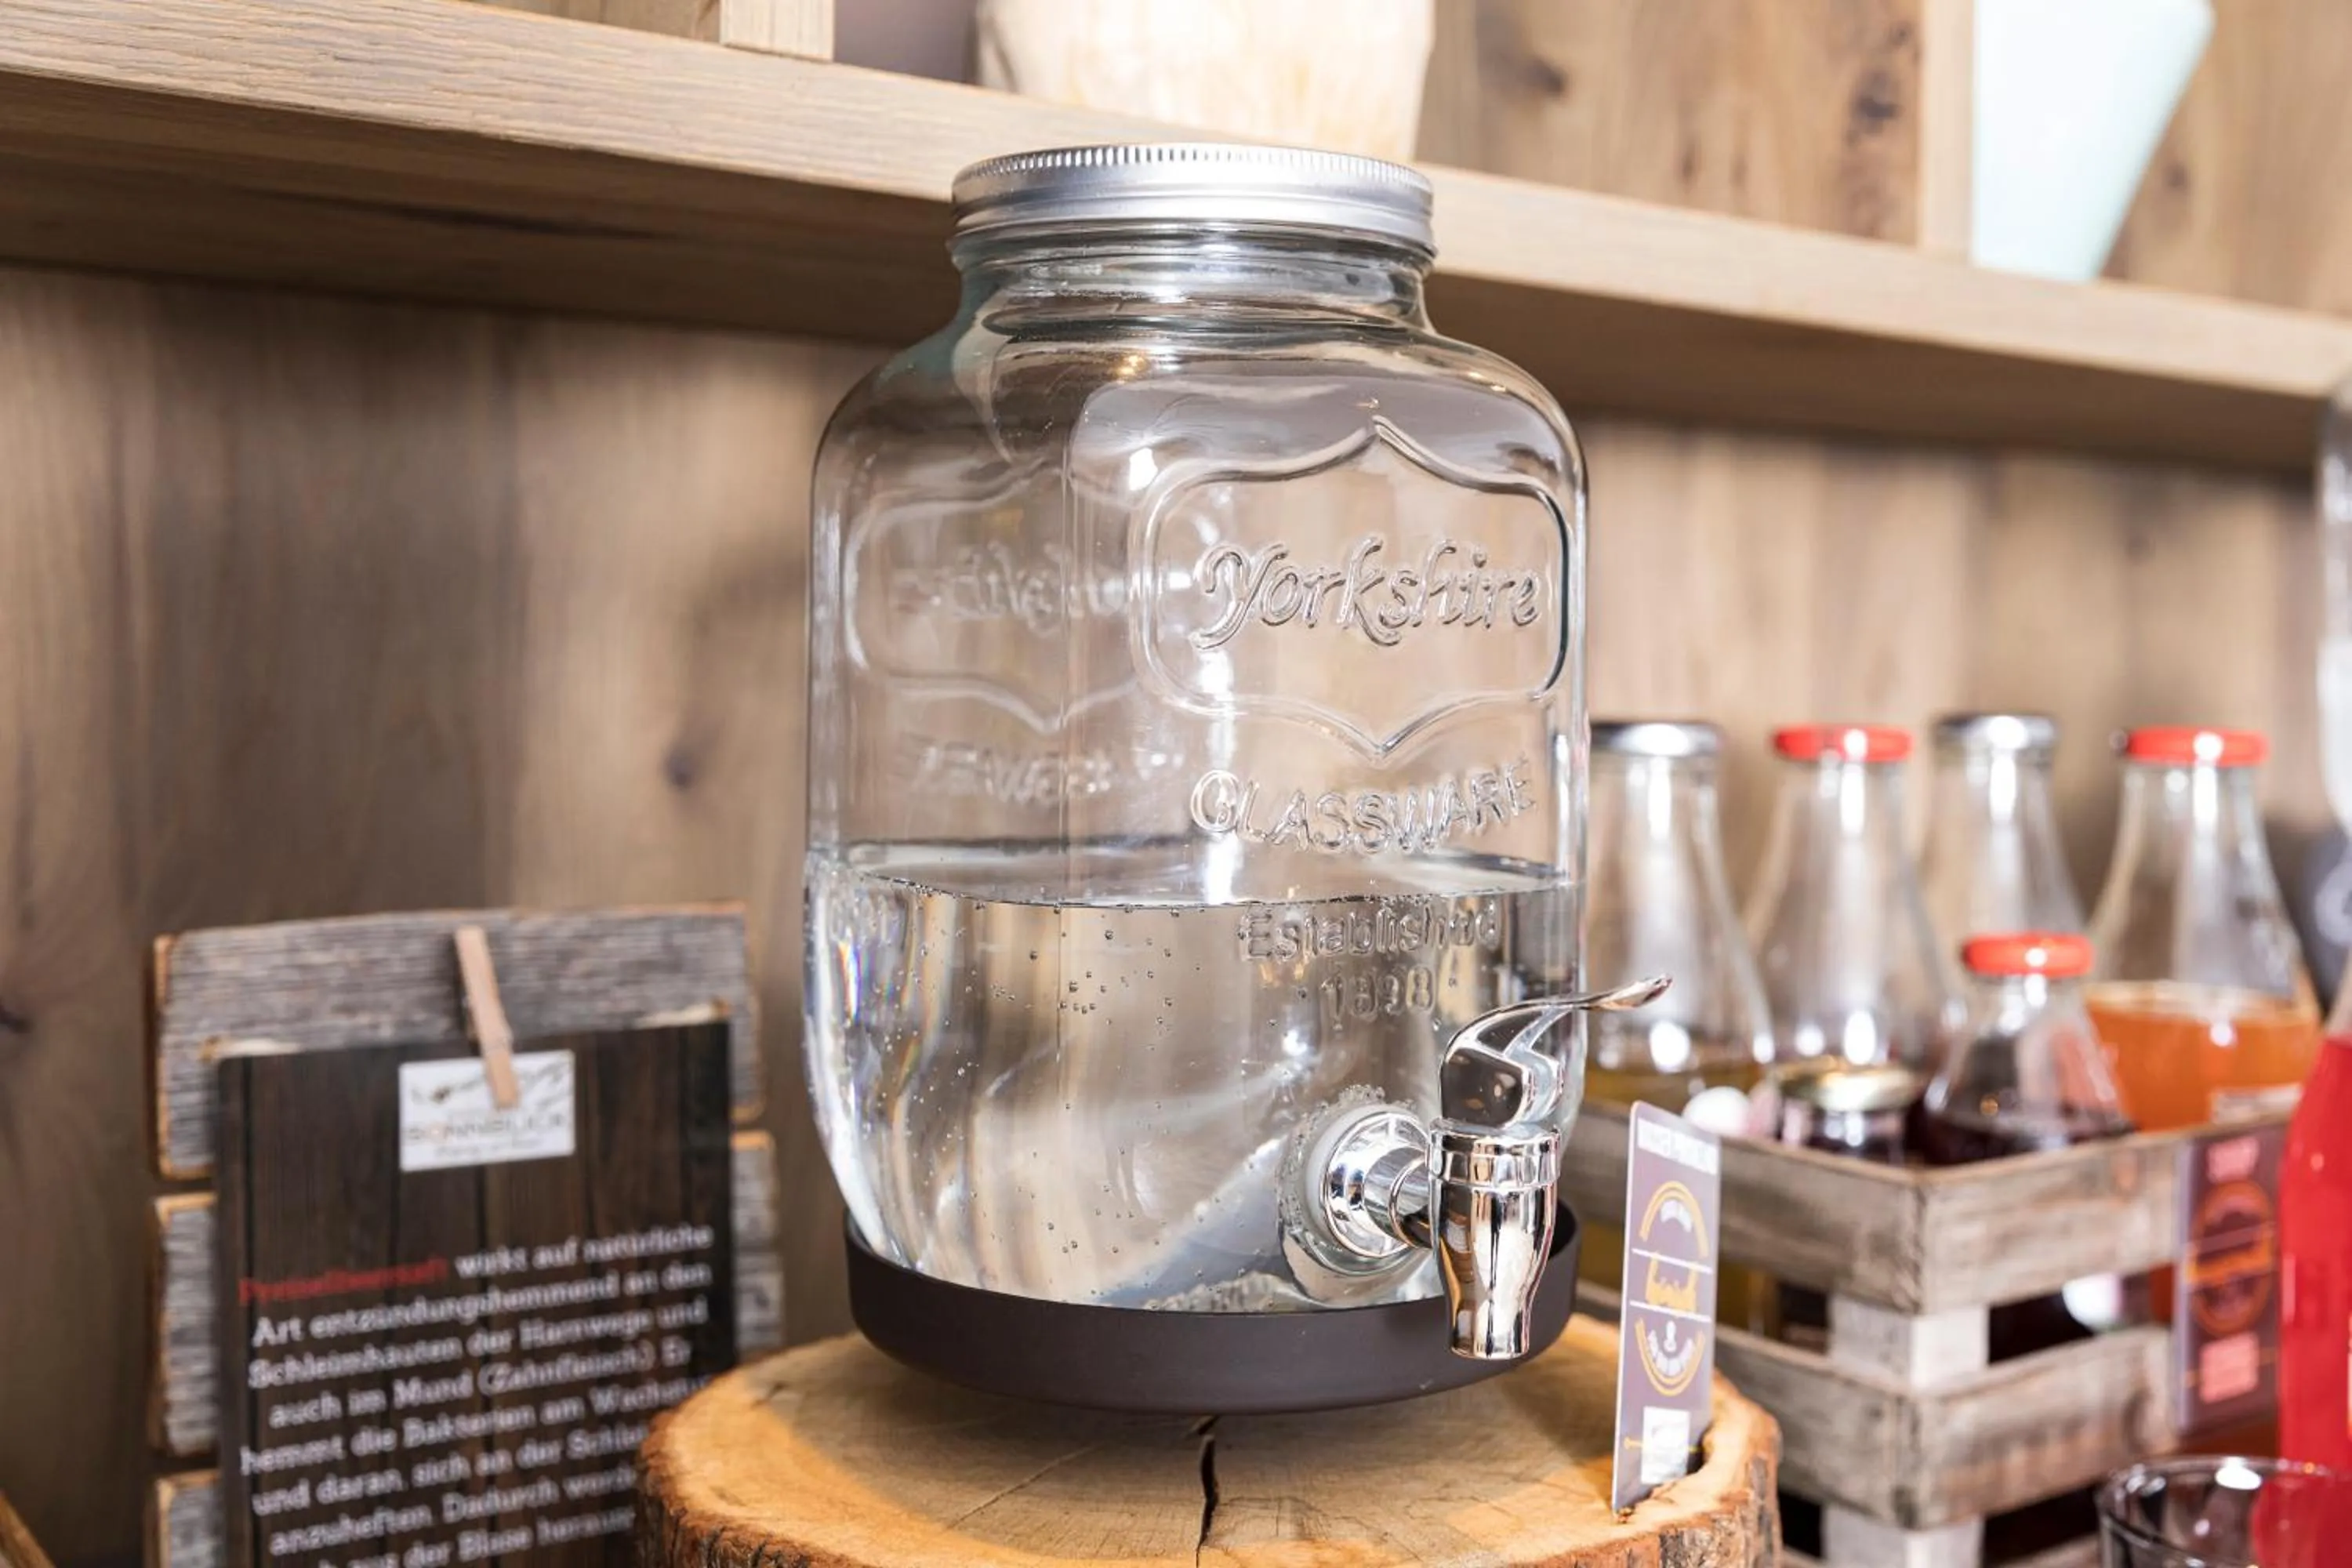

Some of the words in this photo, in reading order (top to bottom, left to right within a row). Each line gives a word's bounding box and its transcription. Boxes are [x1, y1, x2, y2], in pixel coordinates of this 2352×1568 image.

[1191, 537, 1541, 649] Yorkshire
[1190, 754, 1537, 854] GLASSWARE
[532, 1235, 579, 1269] auf
[252, 1316, 303, 1348] Art
[623, 1270, 659, 1296] an
[662, 1259, 713, 1290] den
[466, 1328, 514, 1357] der
[656, 1294, 709, 1330] und
[269, 1390, 343, 1429] auch
[347, 1388, 387, 1416] im
[394, 1368, 474, 1410] Mund
[350, 1425, 397, 1457] die
[539, 1396, 586, 1425] am
[251, 1476, 310, 1516] und
[412, 1452, 471, 1488] sich
[474, 1450, 513, 1477] an
[516, 1438, 563, 1468] der
[442, 1475, 560, 1524] Dadurch
